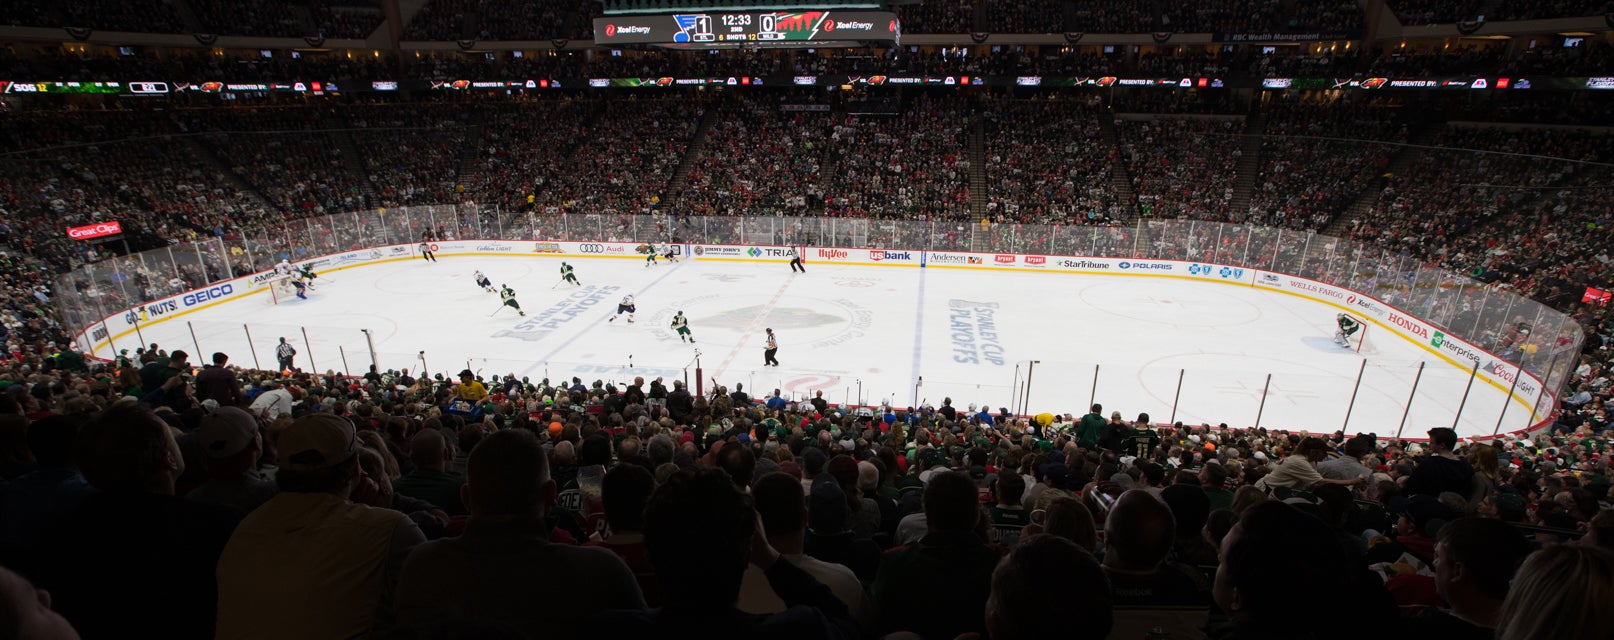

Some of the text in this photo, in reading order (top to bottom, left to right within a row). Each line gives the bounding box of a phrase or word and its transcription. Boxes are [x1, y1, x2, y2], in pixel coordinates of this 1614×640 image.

[699, 18, 706, 33] 1
[722, 14, 751, 25] 12:33
[762, 16, 773, 31] 0
[852, 22, 873, 30] Energy
[631, 26, 650, 34] Energy
[13, 84, 36, 92] SOG
[69, 223, 120, 238] Great Clips
[764, 248, 793, 257] TRIA
[930, 252, 966, 261] Andersen
[1027, 256, 1044, 264] bryant
[1132, 262, 1173, 270] POLARIS
[183, 283, 233, 307] GEICO
[1289, 280, 1317, 292] WELLS
[1318, 287, 1344, 300] FARGO
[149, 299, 179, 317] NUTS!
[540, 285, 621, 330] PLAYOFFS
[1388, 312, 1428, 339] HONDA
[950, 308, 980, 364] PLAYOFFS
[974, 307, 1005, 366] STANLEY CUP
[1432, 335, 1480, 363] enterprise
